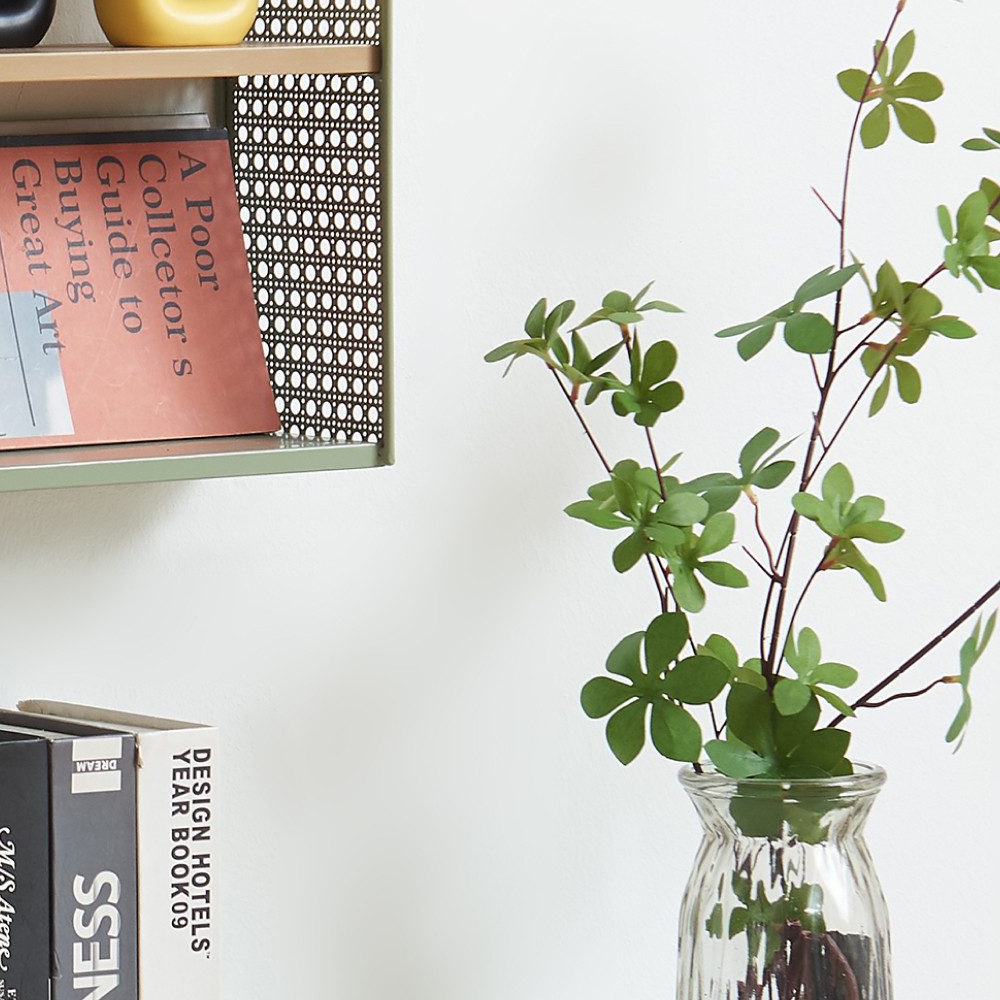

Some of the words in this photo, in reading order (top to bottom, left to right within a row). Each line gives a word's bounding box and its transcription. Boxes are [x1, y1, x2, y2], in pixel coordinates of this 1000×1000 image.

[178, 151, 207, 181] A
[12, 158, 52, 276] Great
[32, 289, 66, 355] Art
[52, 156, 96, 304] Buying
[96, 155, 138, 280] Guide
[119, 295, 143, 334] to
[184, 196, 220, 292] Poor
[76, 759, 118, 772] DREAM
[171, 749, 191, 816] YEAR
[191, 748, 212, 842] DESIGN
